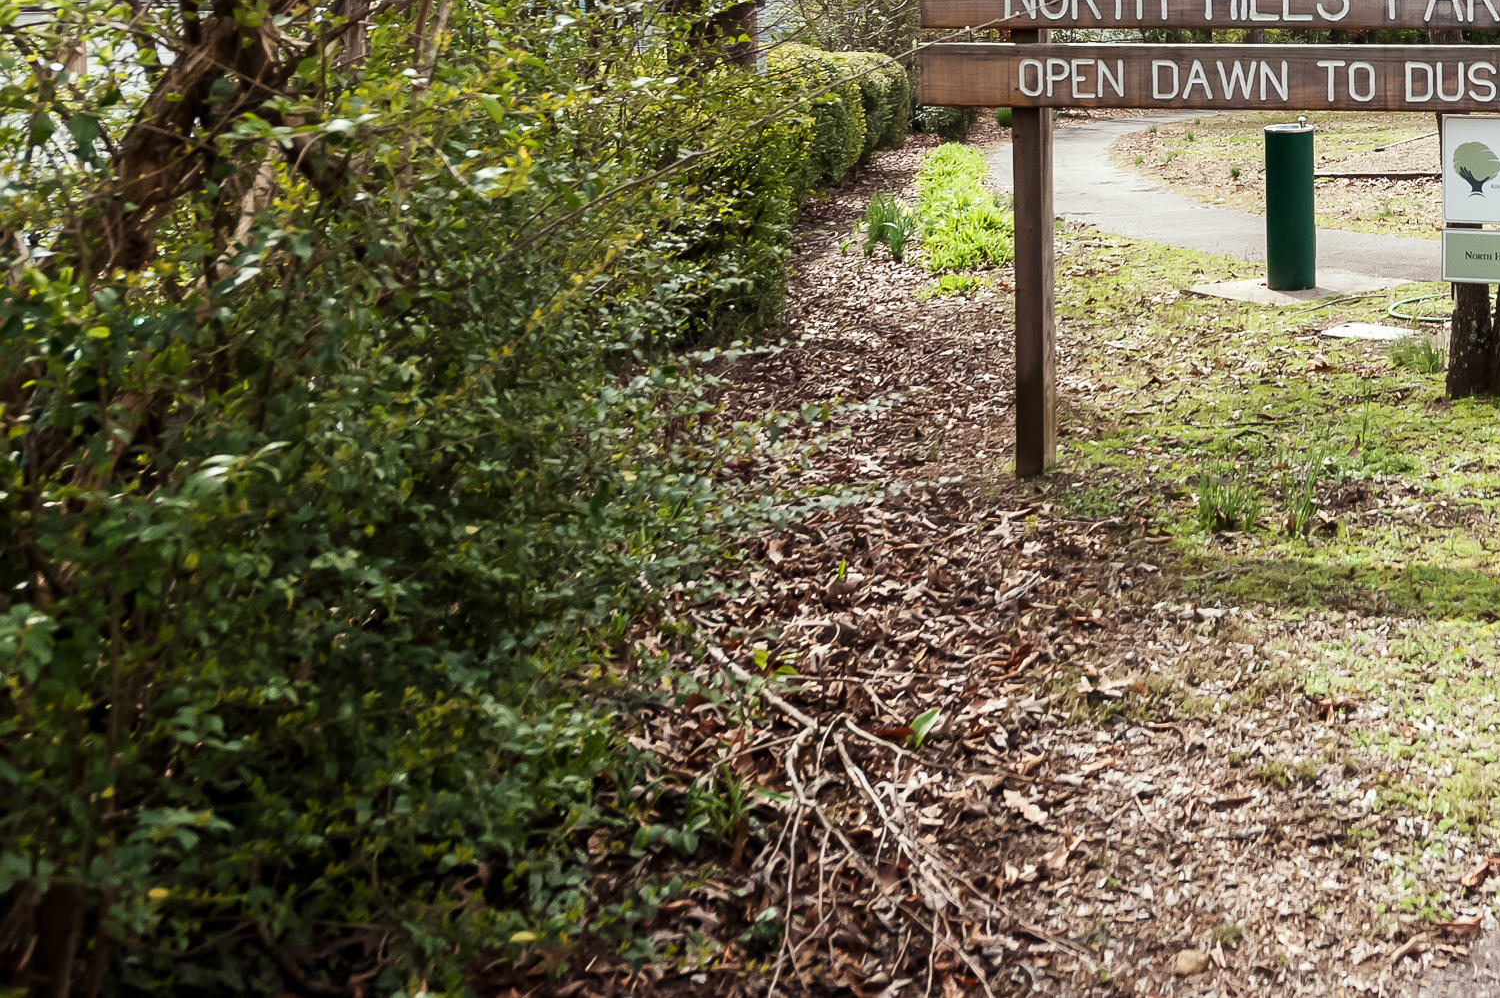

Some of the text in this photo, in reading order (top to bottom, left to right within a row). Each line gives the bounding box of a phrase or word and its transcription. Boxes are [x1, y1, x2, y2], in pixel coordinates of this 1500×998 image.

[1018, 58, 1125, 99] OPEN
[1152, 59, 1289, 102] DAWN
[1316, 60, 1376, 102] TO
